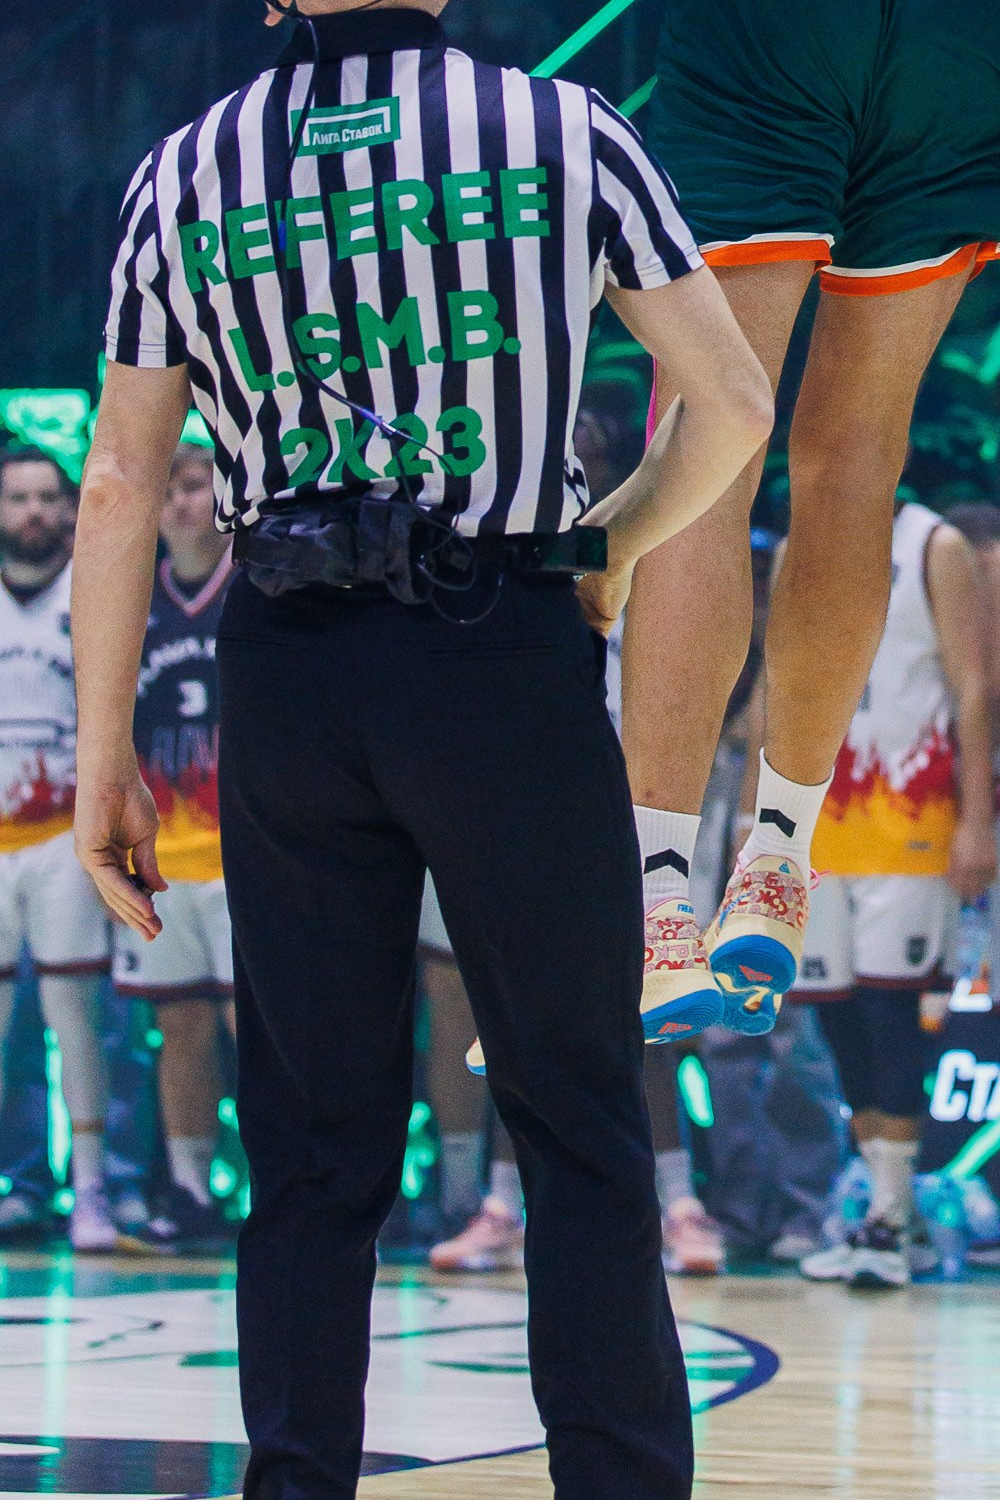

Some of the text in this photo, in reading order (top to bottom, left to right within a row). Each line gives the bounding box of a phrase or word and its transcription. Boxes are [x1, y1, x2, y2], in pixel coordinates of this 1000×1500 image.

[178, 167, 551, 294] REFEREE
[228, 290, 522, 393] L.S.M.B.
[279, 406, 487, 488] 2K23
